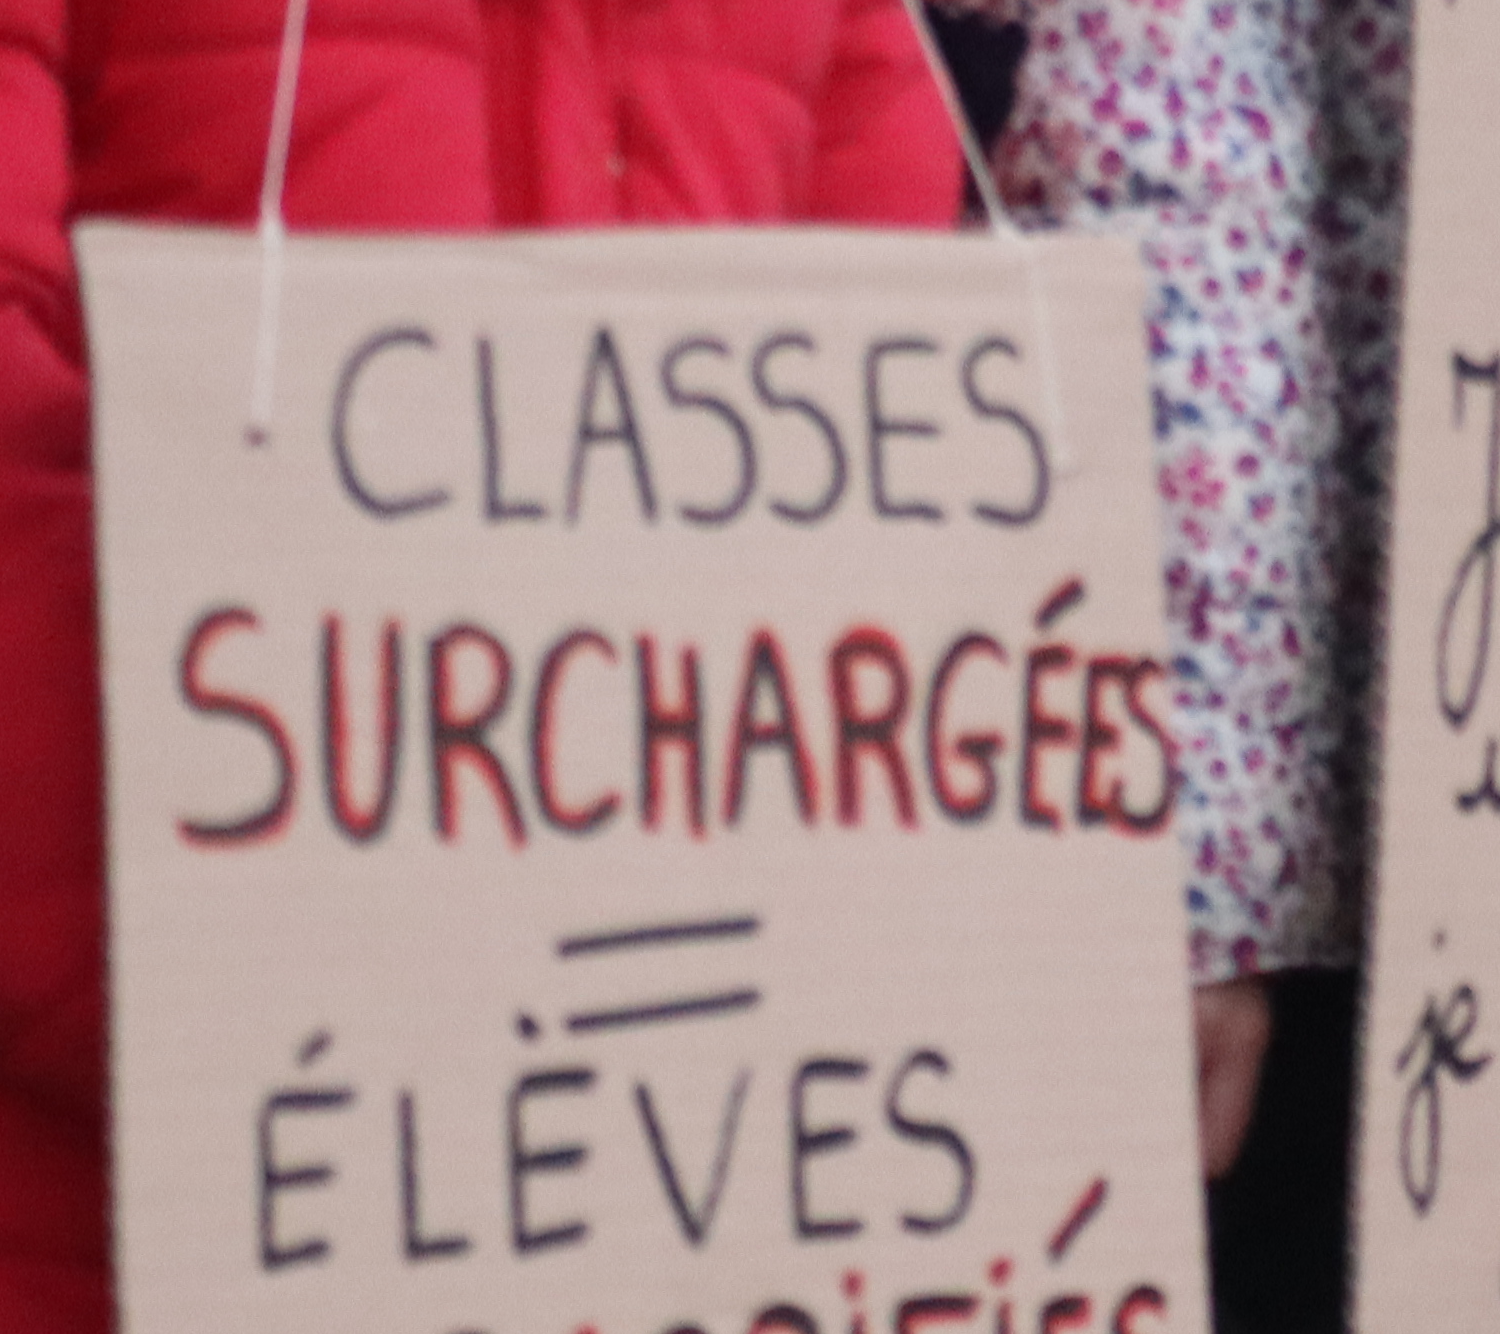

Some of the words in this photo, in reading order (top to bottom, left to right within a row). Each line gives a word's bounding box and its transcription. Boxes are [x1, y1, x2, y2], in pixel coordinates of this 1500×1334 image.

[332, 327, 1051, 526] CLASSES
[176, 577, 1180, 847] SURCHARGÉES
[1396, 931, 1493, 1216] je
